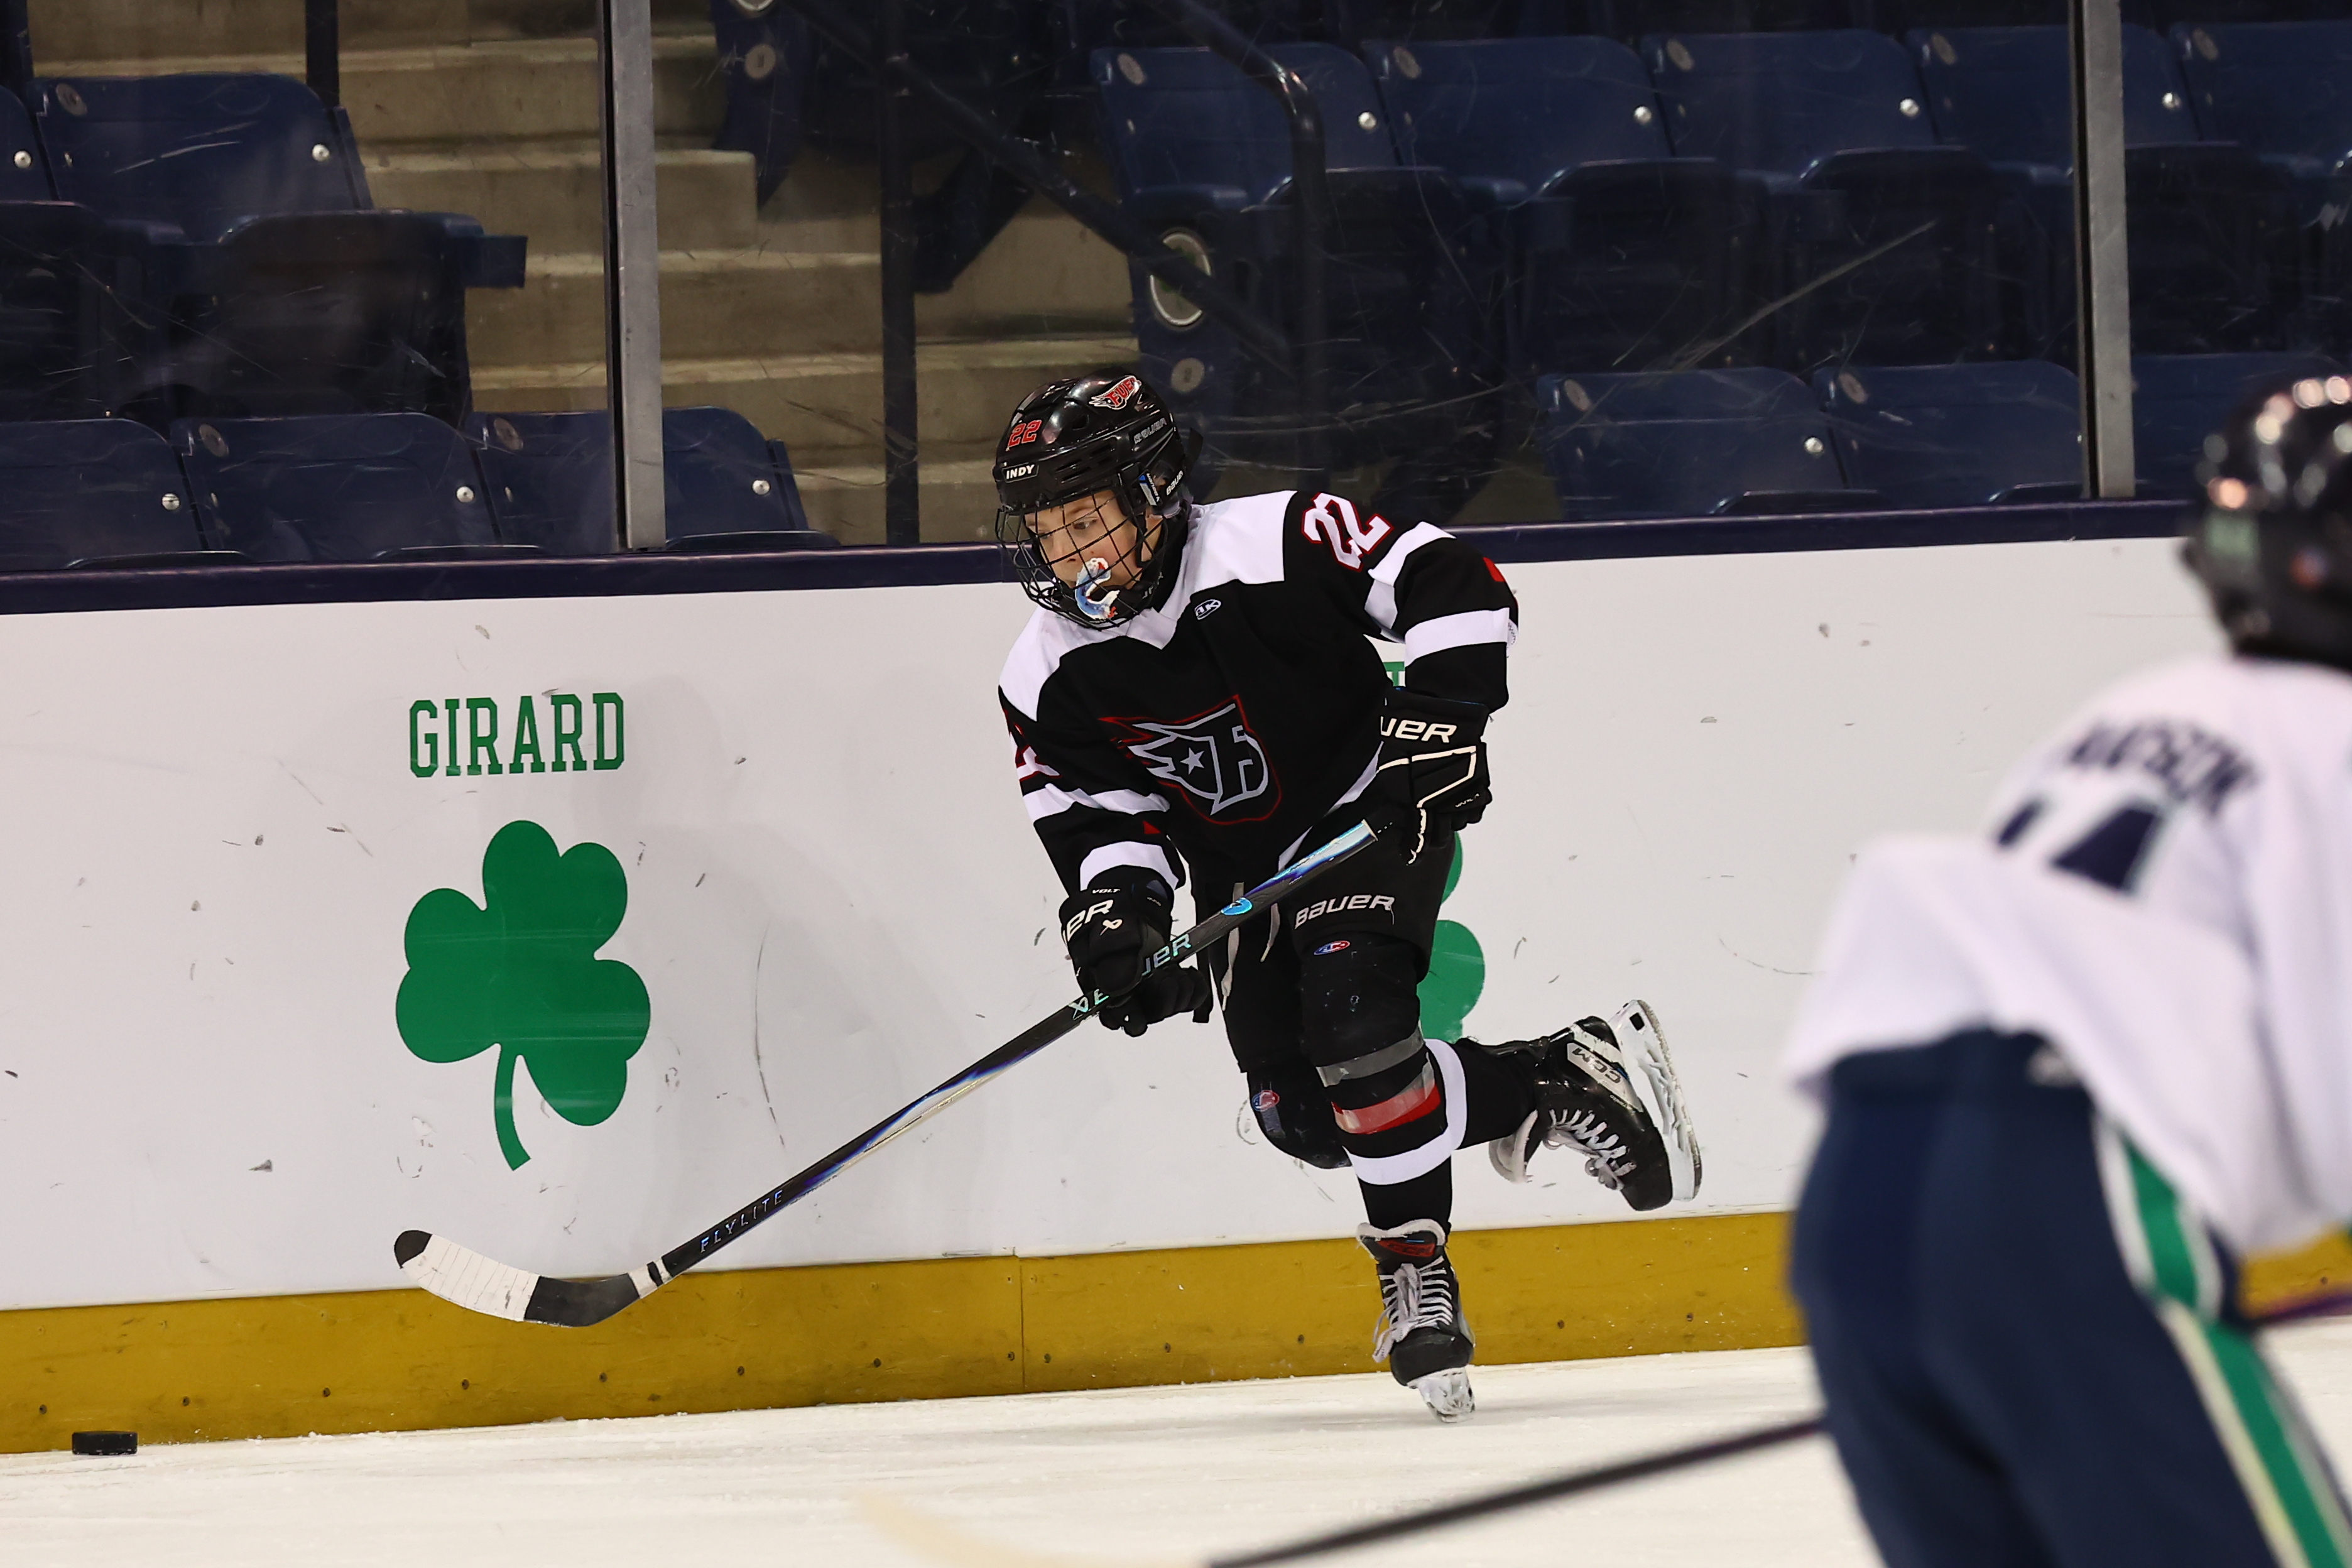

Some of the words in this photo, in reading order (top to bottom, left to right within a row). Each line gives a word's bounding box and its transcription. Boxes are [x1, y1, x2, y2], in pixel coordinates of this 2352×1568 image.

[1008, 420, 1042, 448] 22
[1133, 417, 1167, 444] BAUER
[1006, 464, 1035, 479] INDY
[1302, 493, 1391, 571] 22
[410, 692, 624, 778] GIRARD
[1381, 716, 1457, 743] UER
[1295, 895, 1395, 929] BAUER
[1571, 1047, 1622, 1084] CCM
[700, 1189, 783, 1253] FLYLITE
